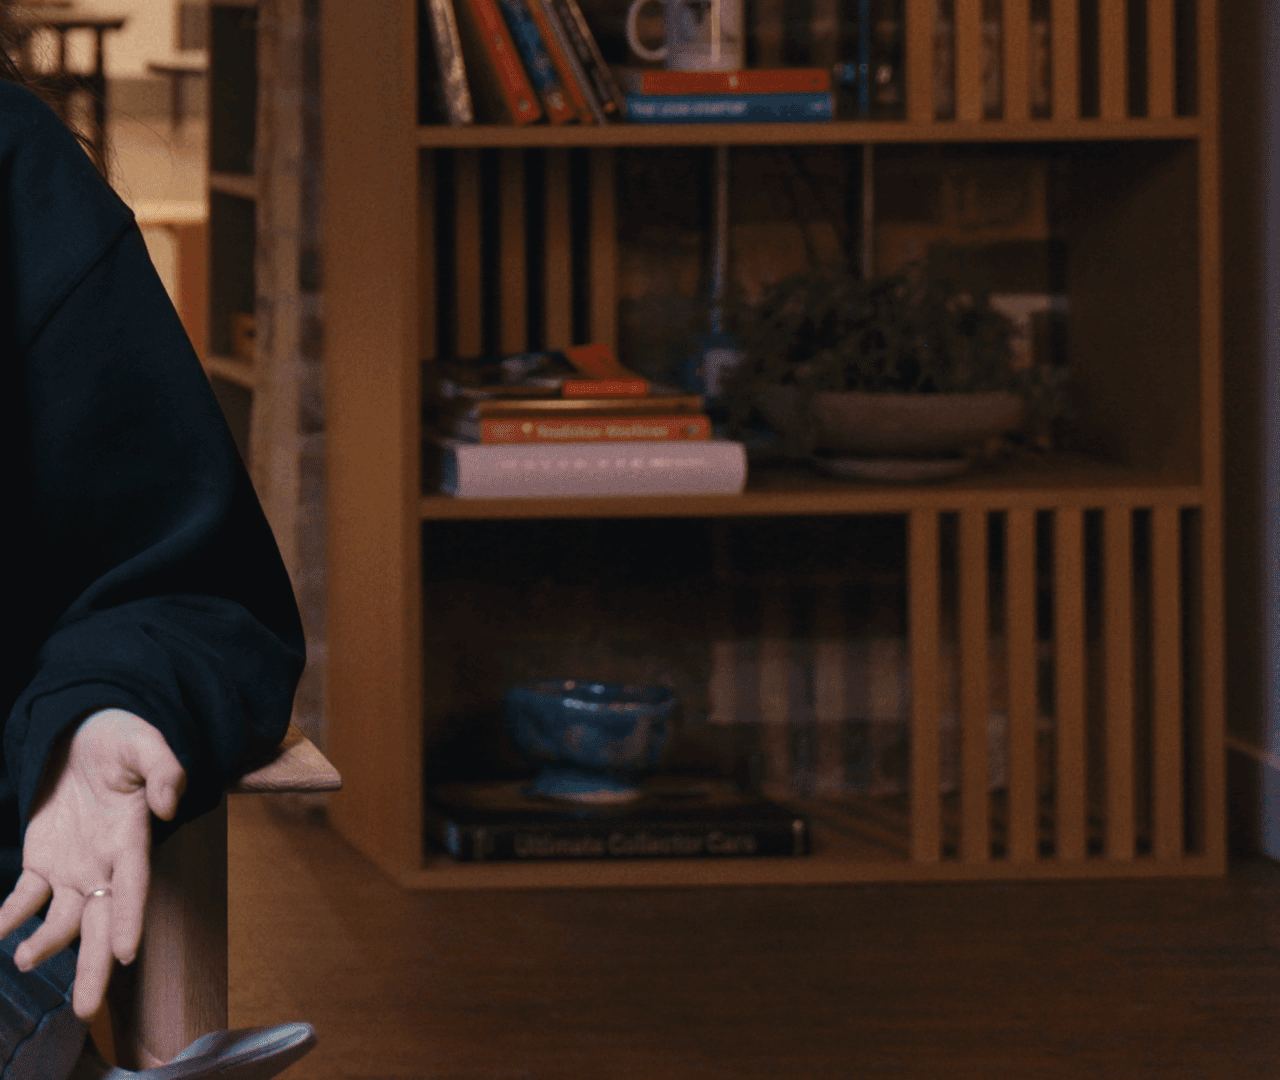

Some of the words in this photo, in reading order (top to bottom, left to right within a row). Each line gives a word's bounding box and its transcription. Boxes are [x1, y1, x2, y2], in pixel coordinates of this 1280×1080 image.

[514, 834, 605, 856] Ultimate
[608, 832, 702, 855] Collector
[706, 831, 756, 853] Cars
